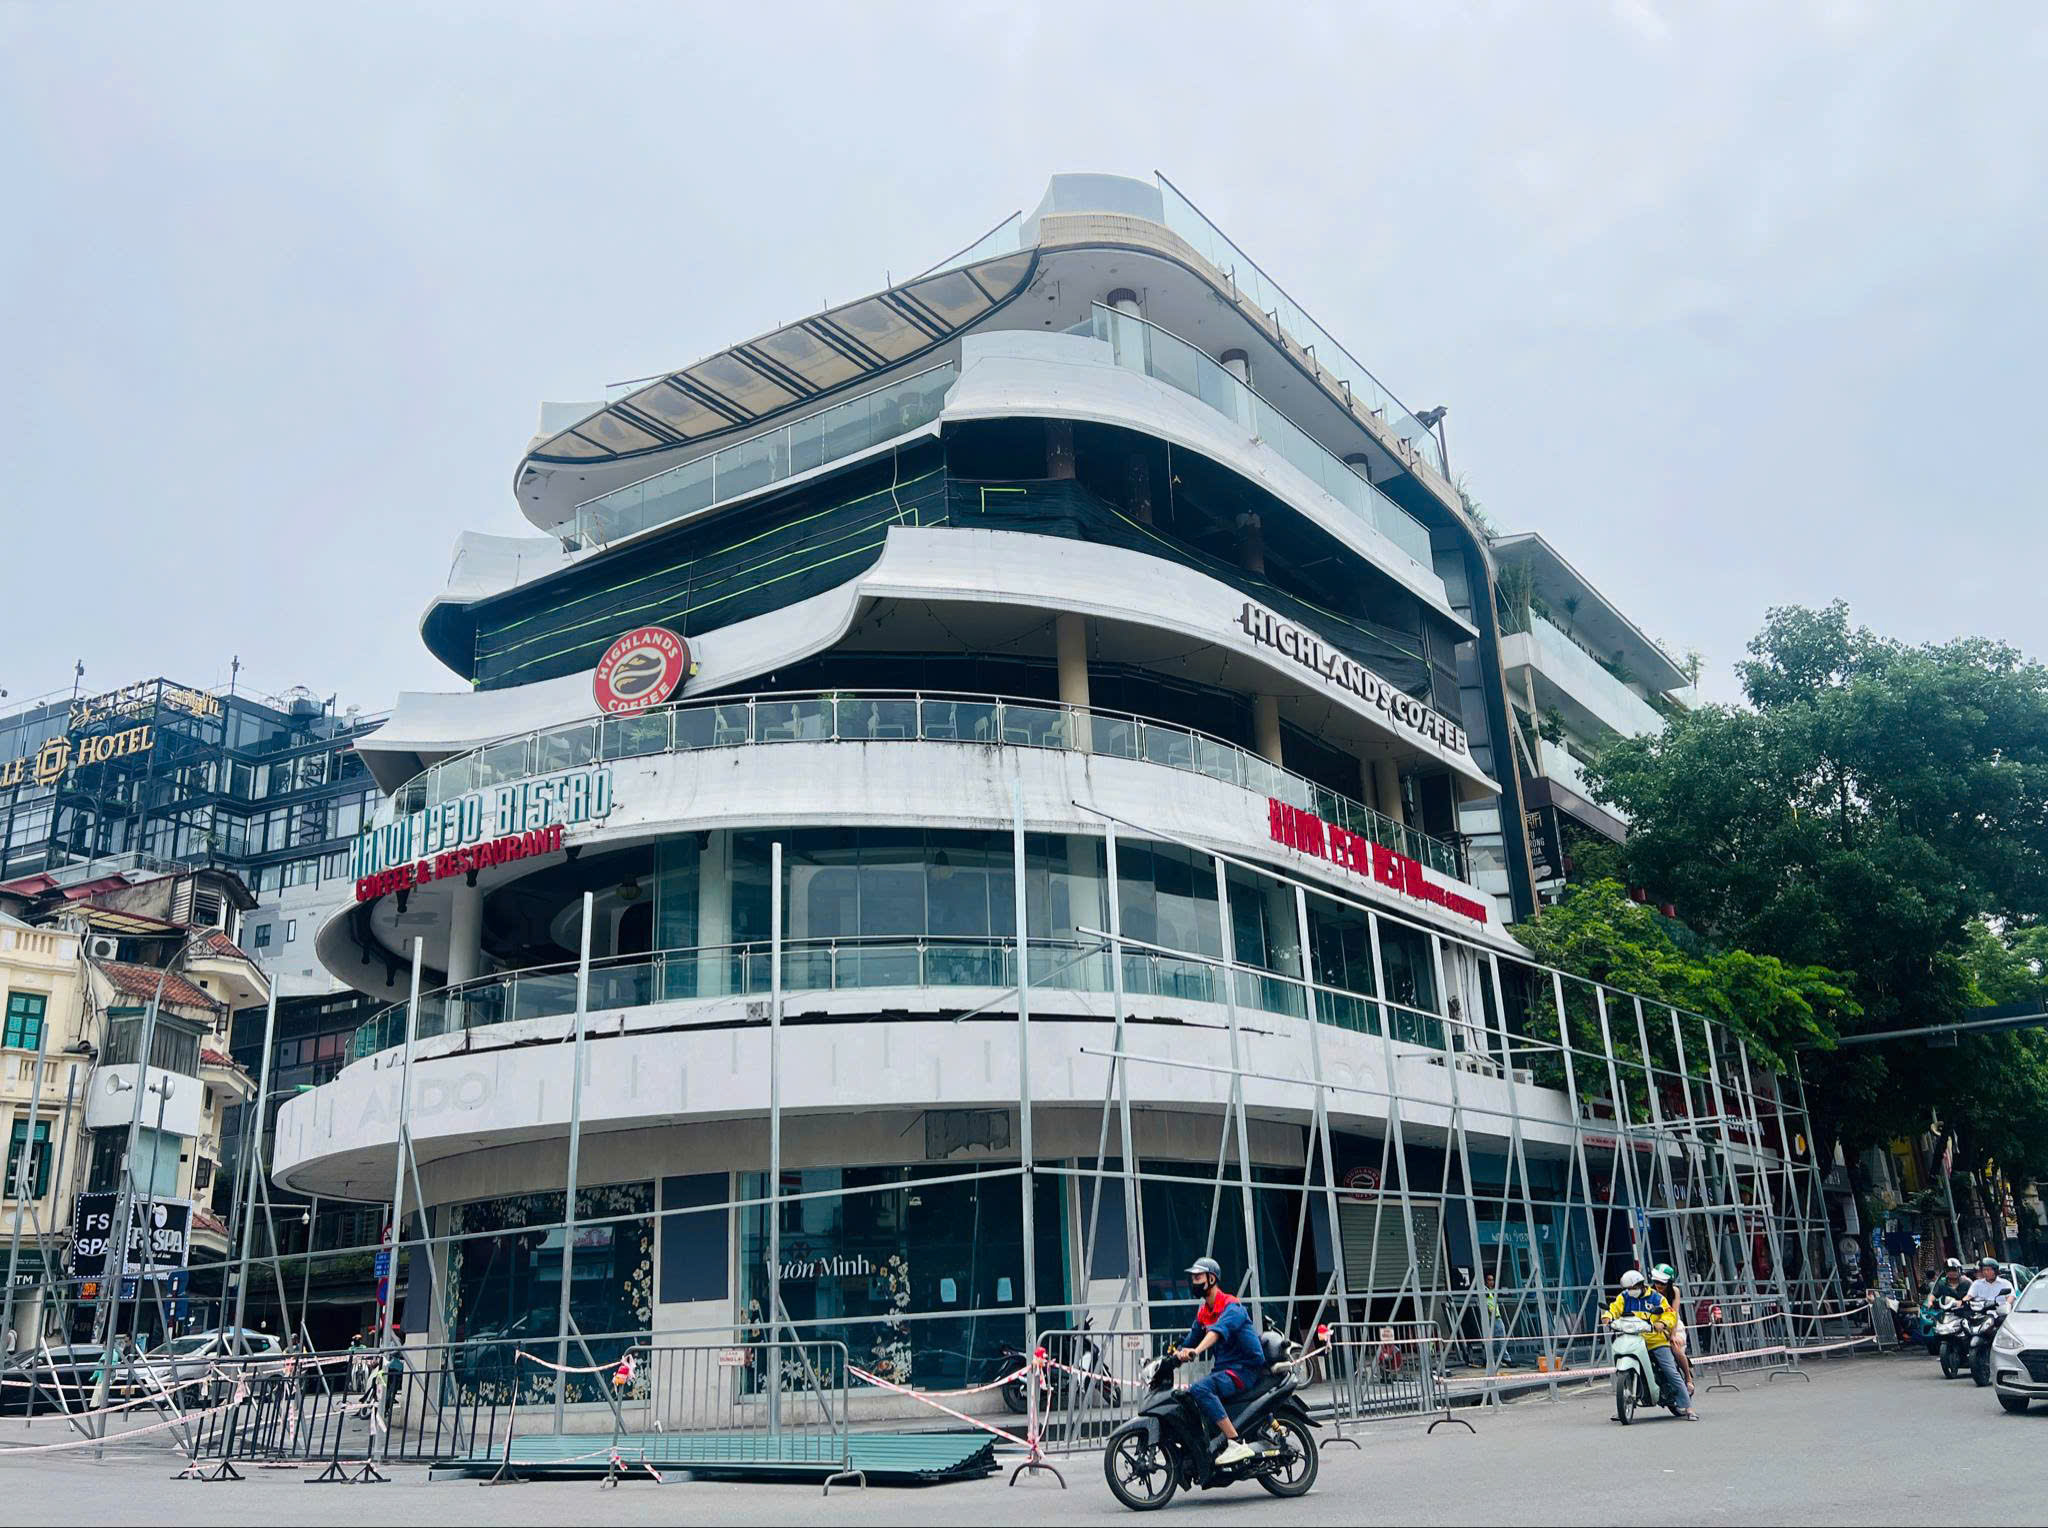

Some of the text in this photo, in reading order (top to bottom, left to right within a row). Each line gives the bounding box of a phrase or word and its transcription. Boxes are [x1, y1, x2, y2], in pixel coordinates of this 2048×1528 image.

[599, 632, 678, 680] HIGHLANDS
[608, 682, 670, 711] COFFEE
[1243, 602, 1466, 755] HIGHLANDS COFFEE
[0, 725, 154, 787] LE HOTEL
[349, 768, 613, 884] HANOI 1930 BISTRO
[356, 824, 564, 902] COFFEE & RESTAURANT
[86, 1213, 110, 1231] FS
[152, 1229, 183, 1252] SPA
[79, 1238, 110, 1255] SPA
[820, 1254, 870, 1277] Mình
